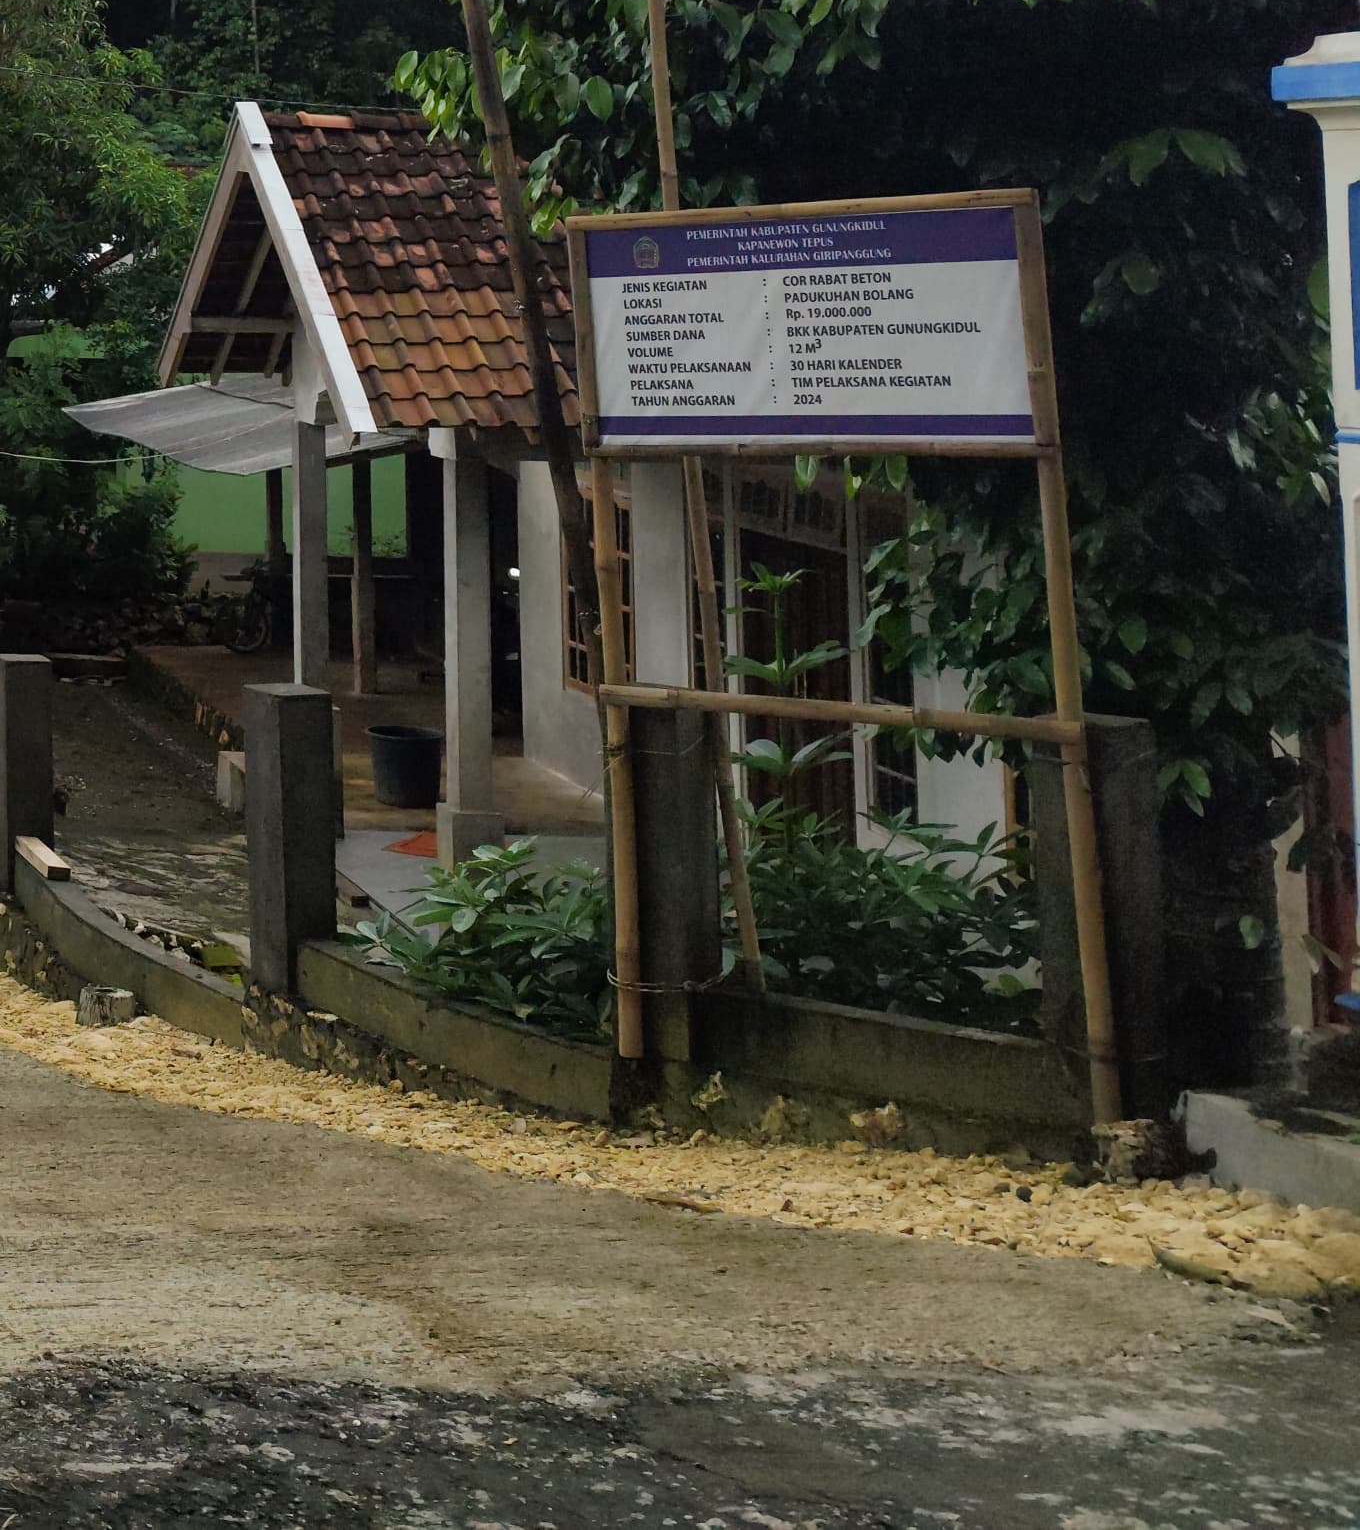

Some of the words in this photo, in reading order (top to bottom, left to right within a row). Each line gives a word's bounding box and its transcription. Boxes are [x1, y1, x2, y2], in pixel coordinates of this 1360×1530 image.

[686, 227, 748, 240] PEMERINTAH
[751, 224, 810, 237] KABUPATEN
[812, 220, 888, 233] GUNUNGKIDUL
[738, 238, 799, 251] KAPANEWON
[802, 237, 834, 248] TEPUS
[687, 255, 748, 267] PEMERINTAH
[751, 252, 810, 264] KALURAHAN
[813, 248, 892, 261] GIRIPANGGUNG
[622, 282, 651, 294] JENIS
[653, 280, 707, 292] KEGIATAN
[783, 275, 807, 287] COR
[809, 274, 848, 286] RABAT
[851, 272, 892, 284] BETON
[623, 298, 662, 309] LOKASI
[784, 291, 860, 303] PADUKUHAN
[863, 288, 914, 301] BOLANG
[624, 314, 686, 326] ANGGARAN
[688, 313, 724, 324] TOTAL
[786, 308, 805, 321] Rp.
[807, 306, 872, 319] 19.000.000
[626, 331, 671, 342] SUMBER
[673, 330, 706, 341] DANA
[787, 326, 810, 337] BKK
[813, 324, 884, 336] KABUPATEN
[887, 322, 981, 335] GUNUNGKIDUL
[627, 347, 674, 358] VOLUME
[789, 343, 803, 354] 12
[628, 363, 668, 374] WAKTU
[671, 361, 752, 373] PELAKSANAAN
[791, 360, 805, 371] 30
[807, 359, 836, 371] HARI
[838, 358, 902, 370] KALENDER
[630, 379, 694, 390] PELAKSANA
[792, 377, 813, 388] TIM
[816, 376, 886, 388] PELAKSANA
[889, 375, 952, 387] KEGIATAN
[632, 396, 669, 406] TAHUN
[672, 395, 736, 406] ANGGARAN
[793, 394, 822, 405] 2024
